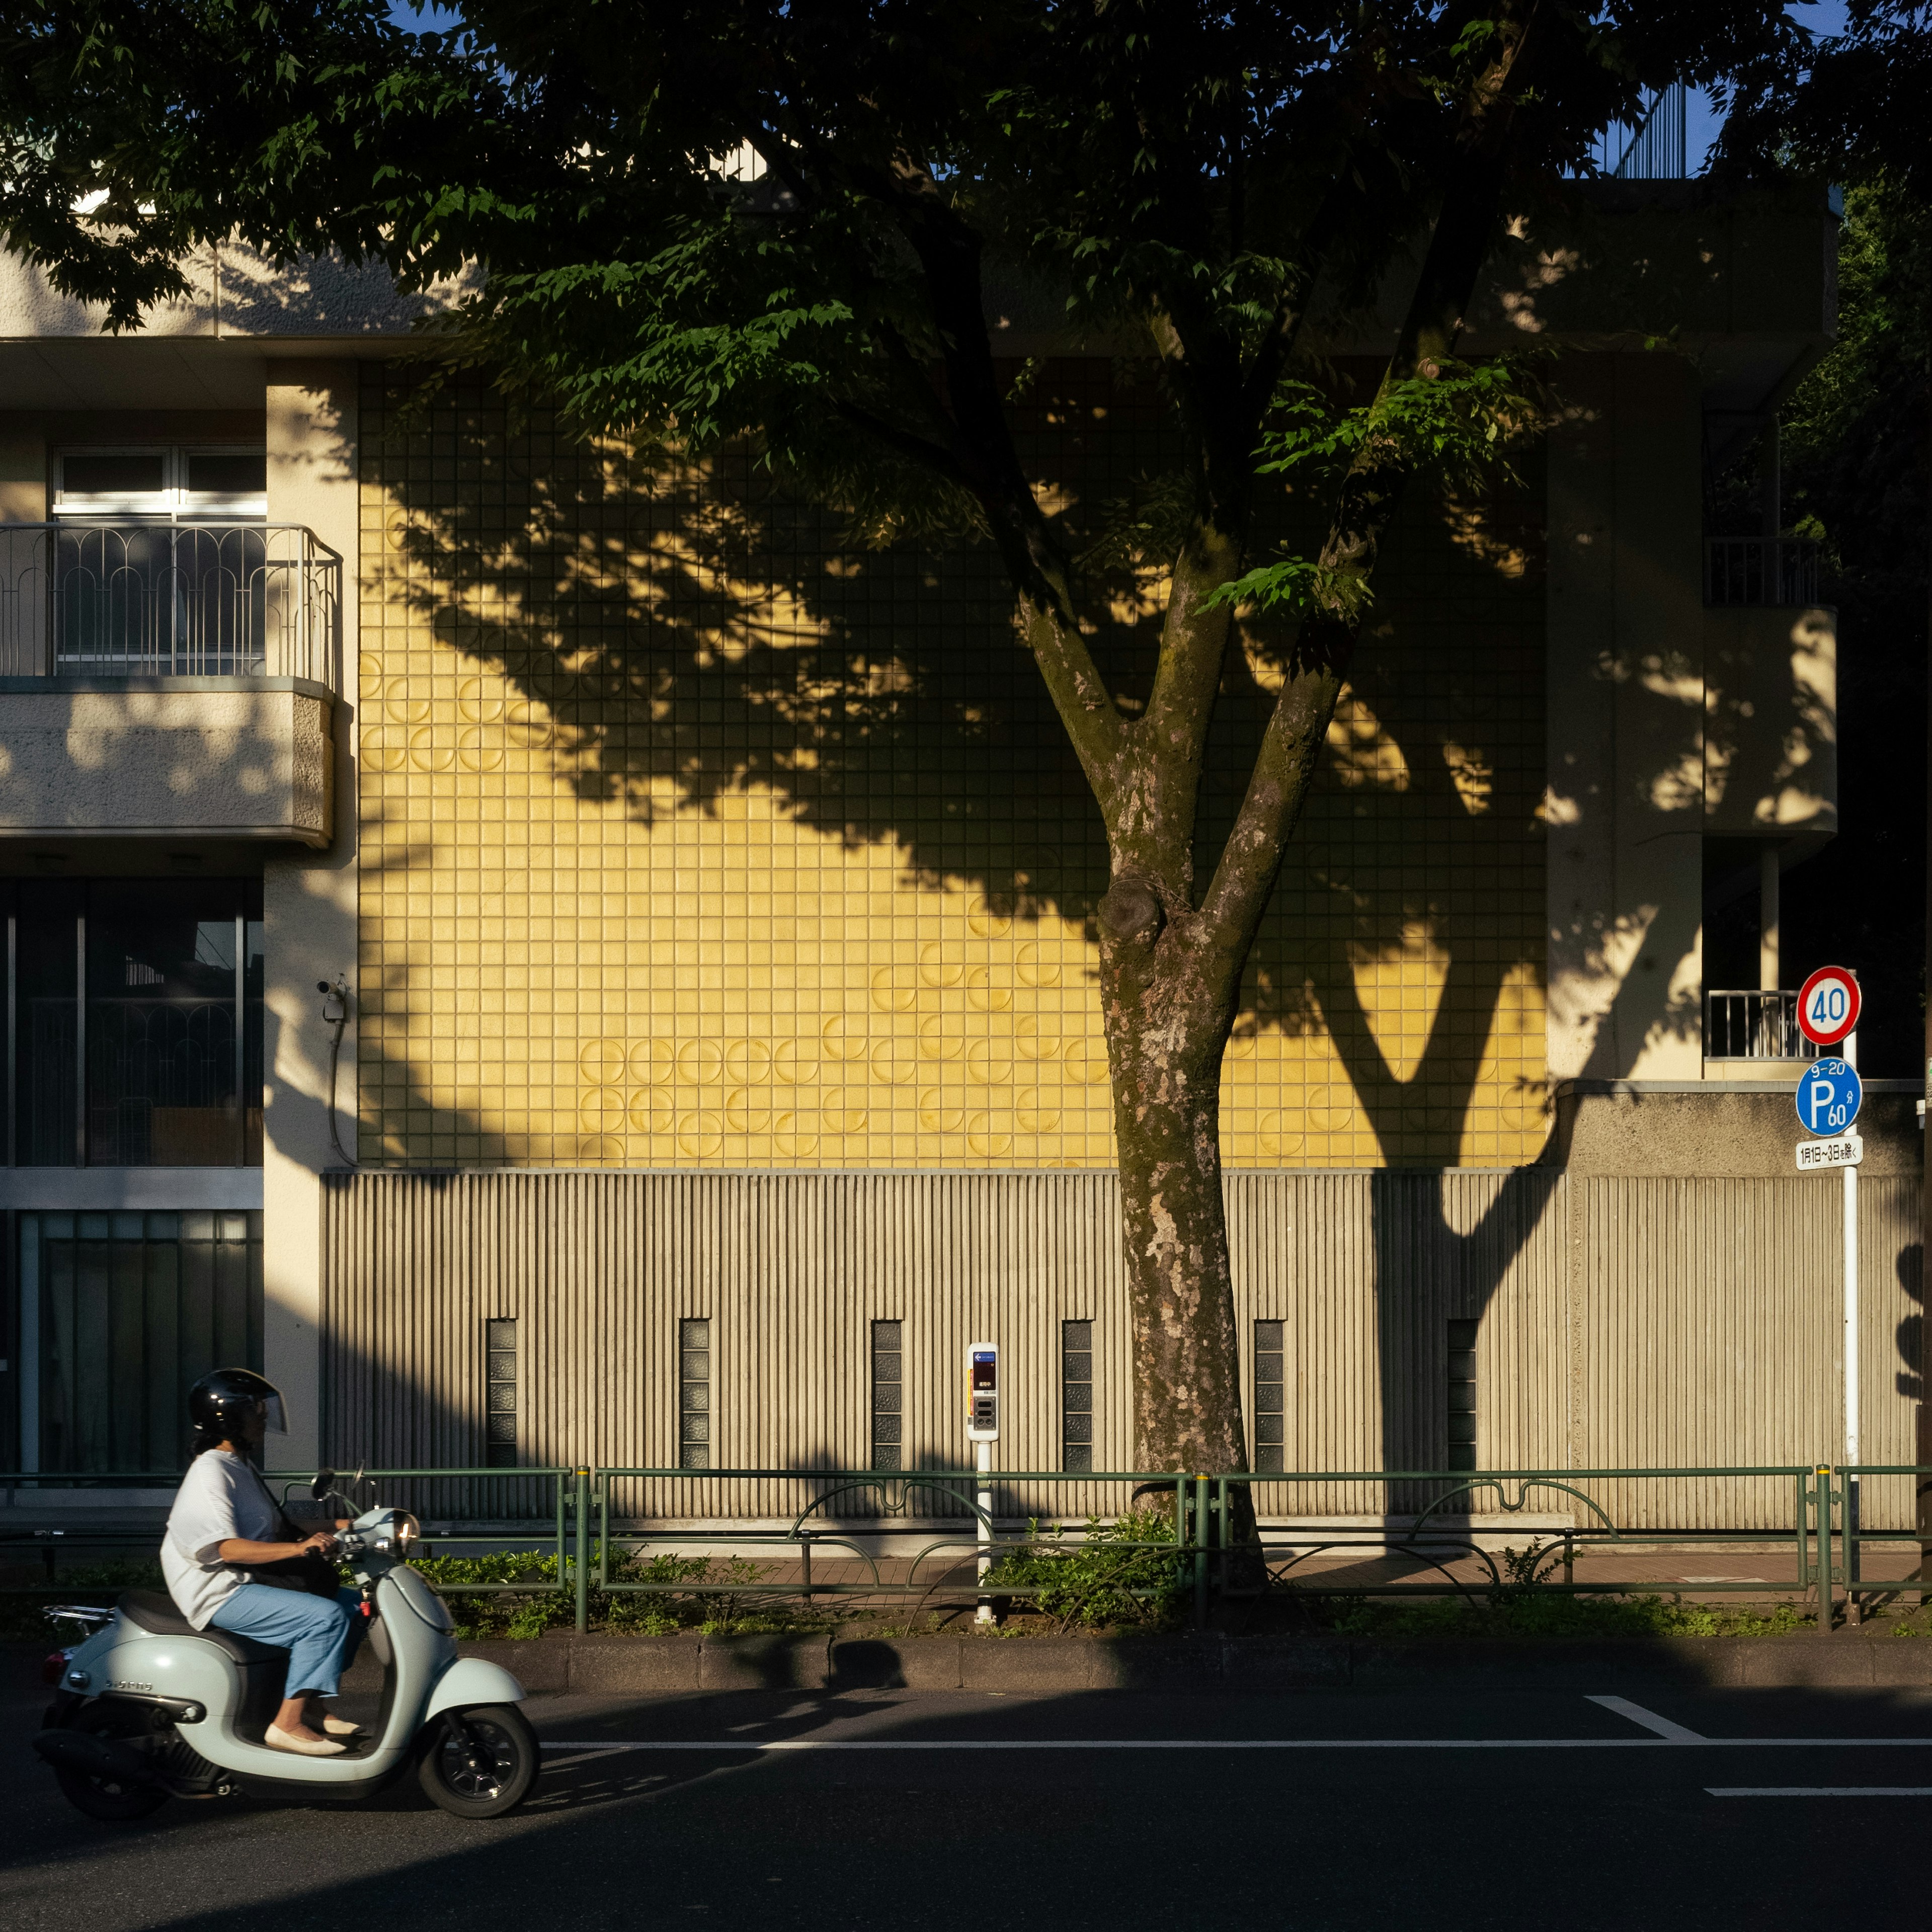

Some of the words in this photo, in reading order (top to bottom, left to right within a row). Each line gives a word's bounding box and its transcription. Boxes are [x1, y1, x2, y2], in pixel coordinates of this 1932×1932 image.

[1812, 988, 1844, 1023] 40
[1811, 1062, 1845, 1078] 9-20
[1811, 1080, 1835, 1129] P
[1828, 1104, 1846, 1126] 60
